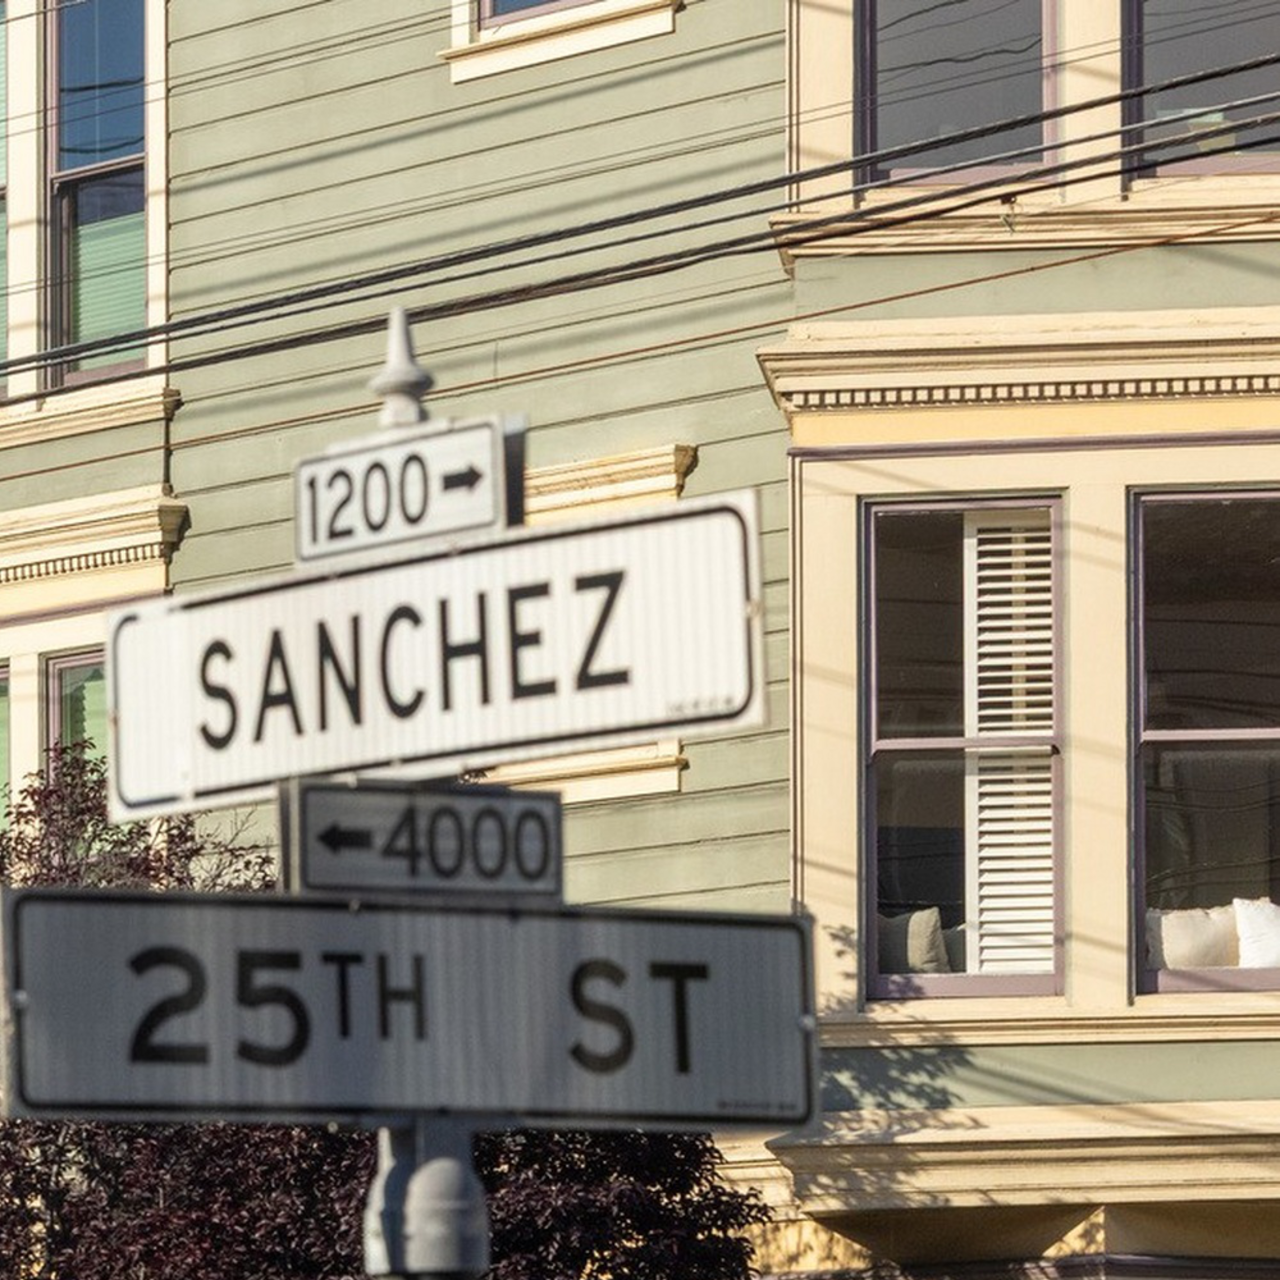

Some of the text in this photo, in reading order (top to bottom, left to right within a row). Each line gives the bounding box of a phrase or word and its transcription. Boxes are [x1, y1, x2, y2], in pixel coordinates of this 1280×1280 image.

[308, 453, 429, 544] 1200
[197, 569, 631, 753] SANCHEZ
[380, 805, 551, 883] 4000
[127, 945, 711, 1076] 25TH ST
